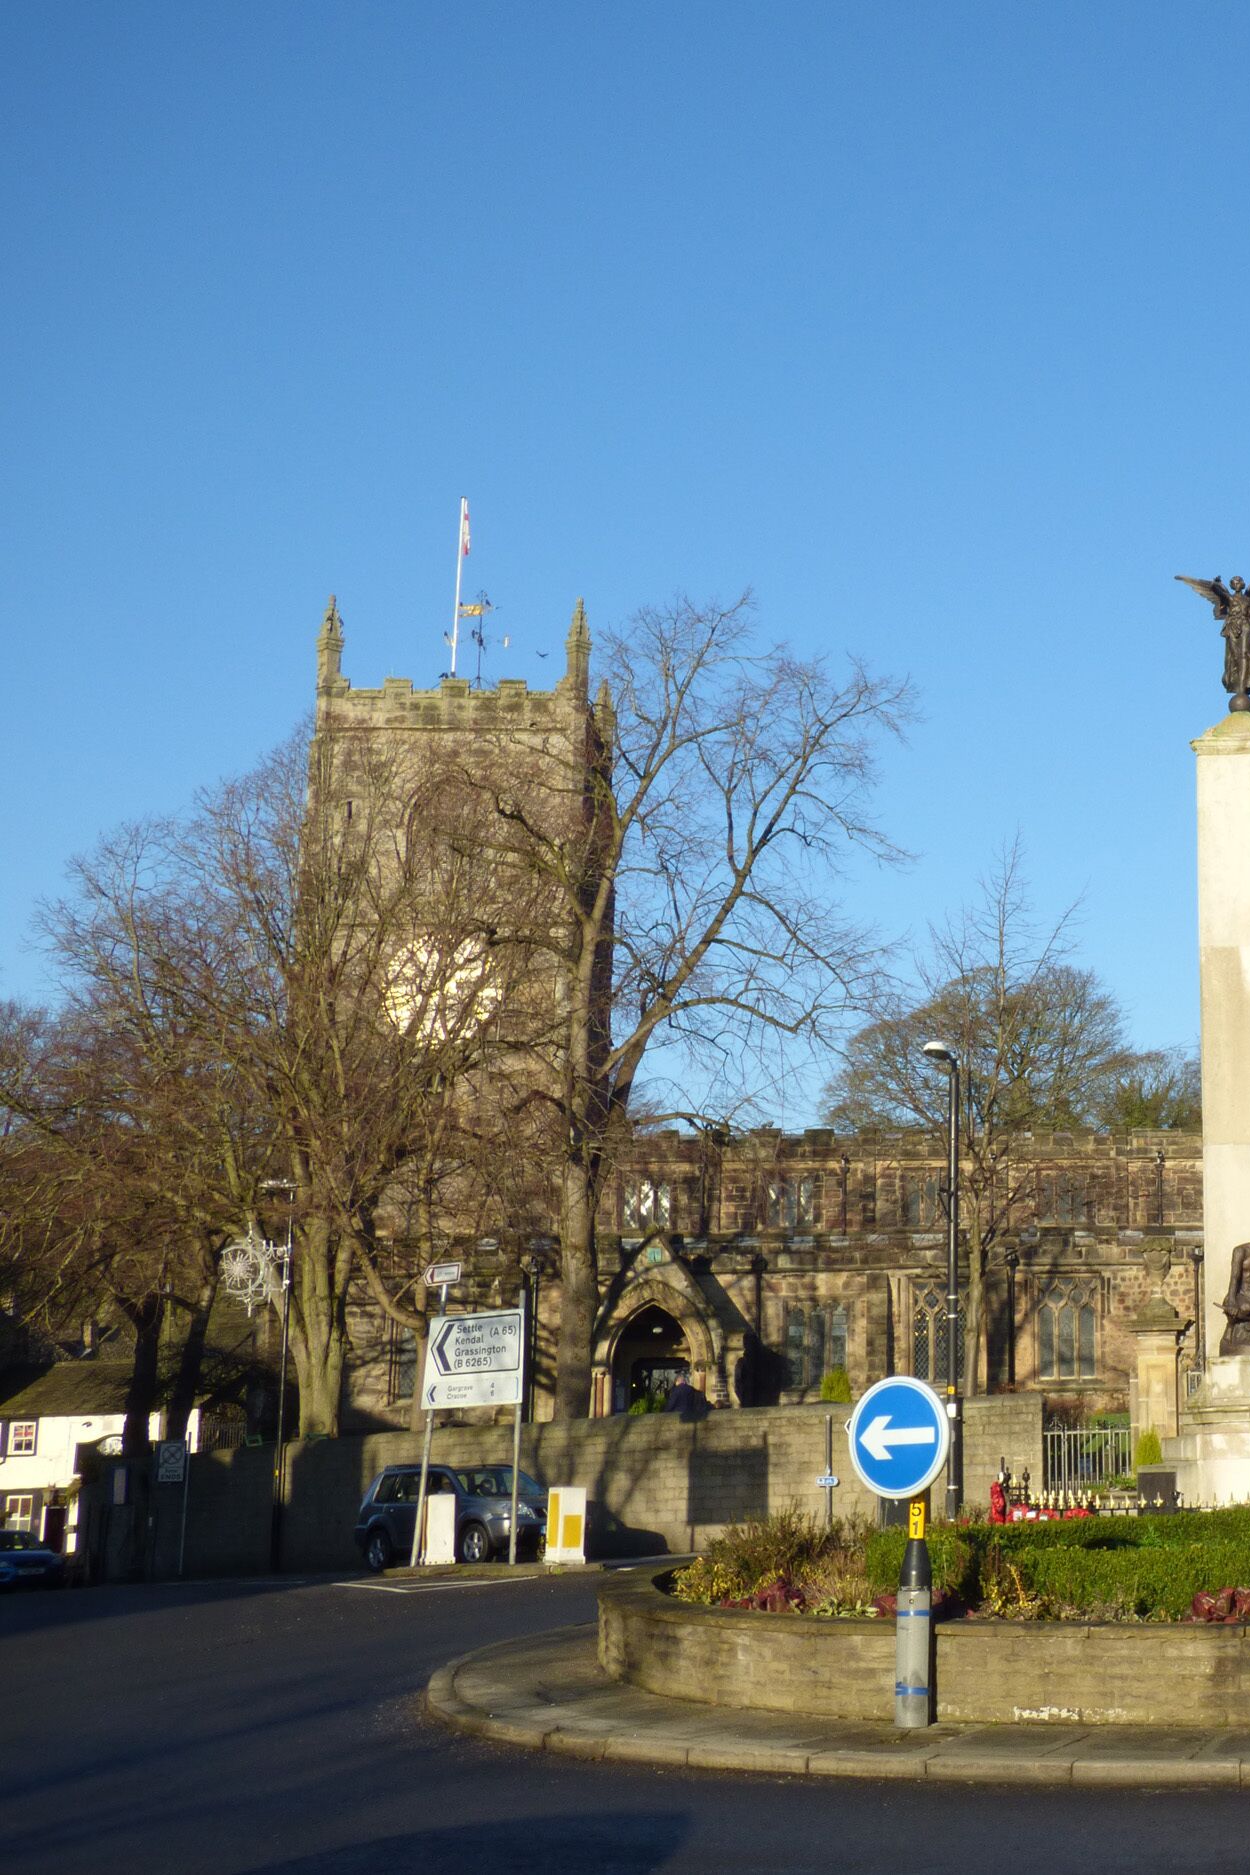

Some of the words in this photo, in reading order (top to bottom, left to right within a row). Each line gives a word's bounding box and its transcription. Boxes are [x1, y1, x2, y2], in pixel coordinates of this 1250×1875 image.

[456, 1324, 483, 1334] Settle
[455, 1335, 484, 1345] Kendal
[454, 1345, 507, 1357] Grassington
